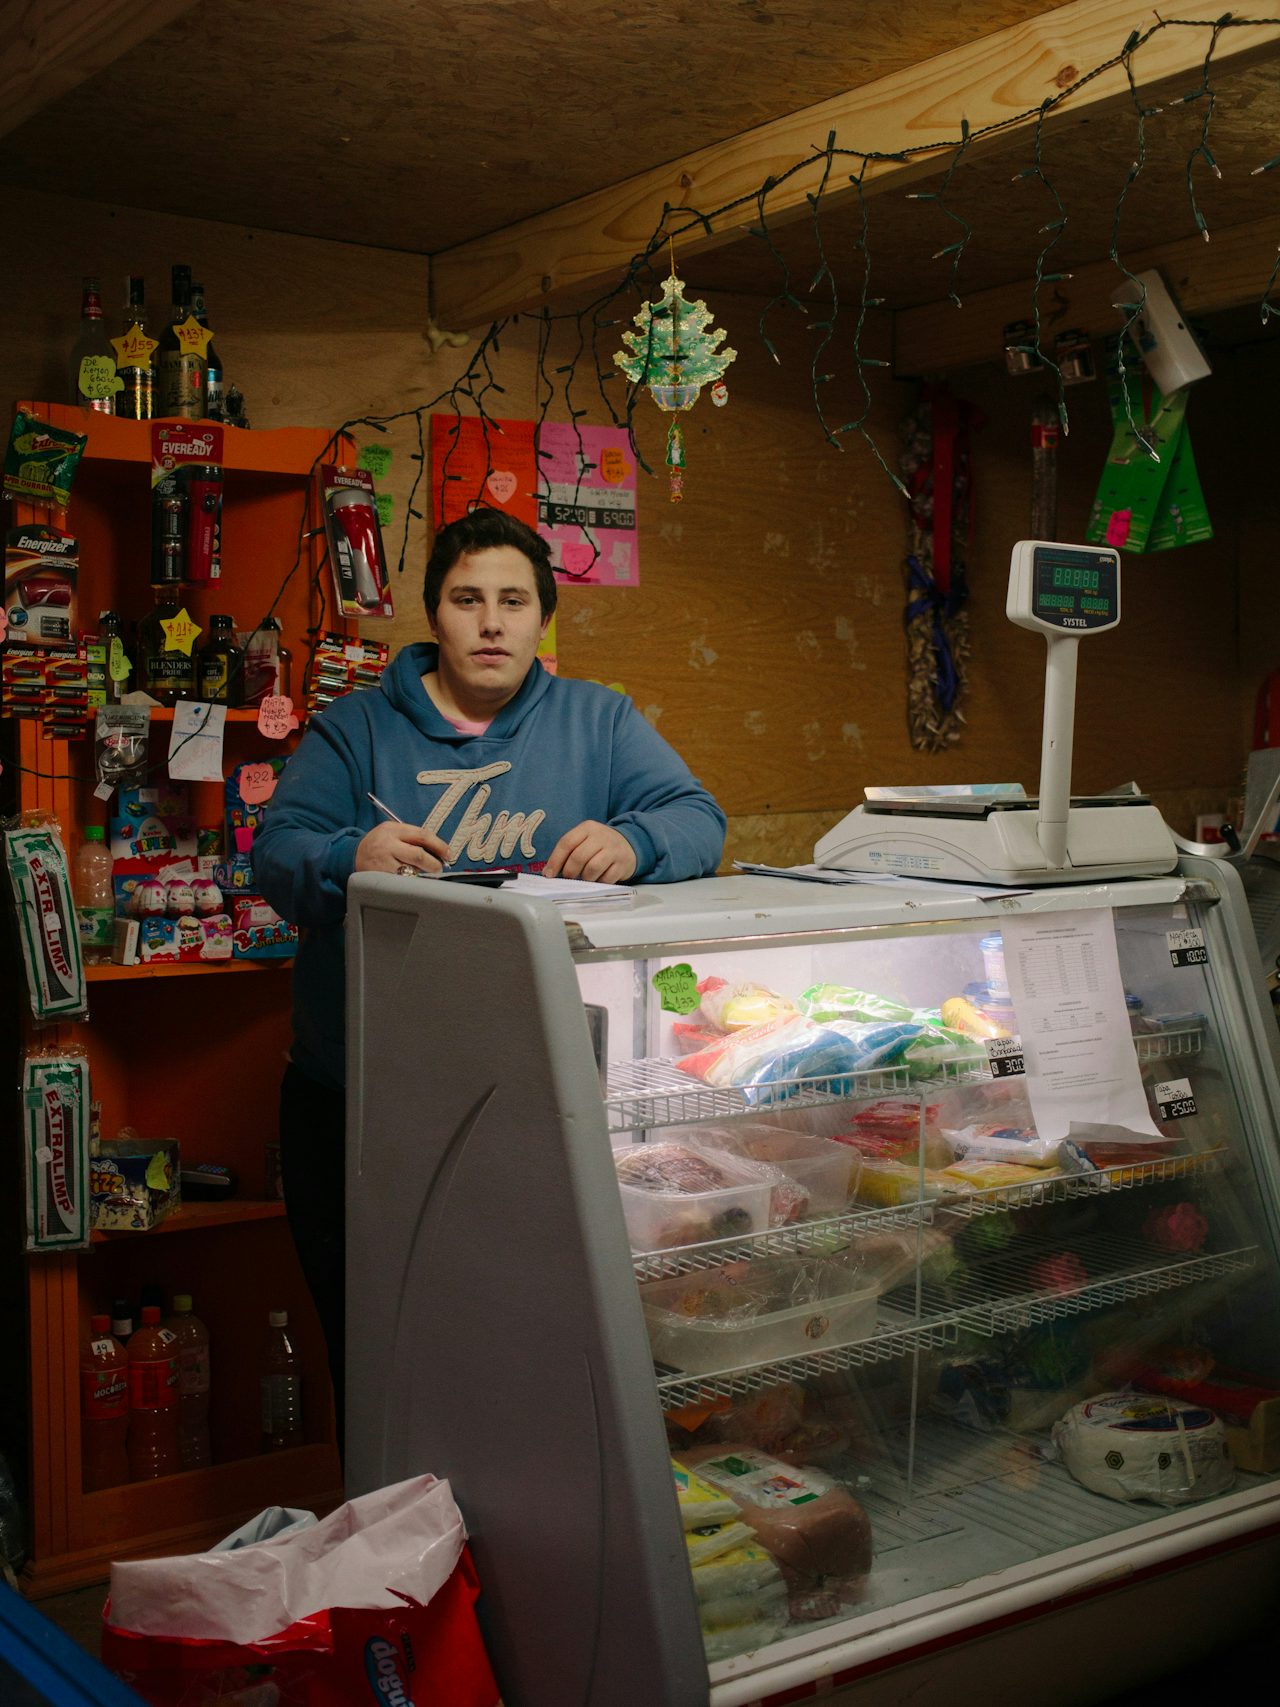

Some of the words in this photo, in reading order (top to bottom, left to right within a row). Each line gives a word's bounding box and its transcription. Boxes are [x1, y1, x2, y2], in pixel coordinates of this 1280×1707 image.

[162, 441, 214, 457] EVEREADY
[333, 475, 364, 489] EVEREADY
[17, 535, 68, 553] Energizer
[1063, 617, 1088, 628] SYSTEL
[150, 659, 192, 670] BLENDERS
[29, 857, 70, 978] EXTRLIMP
[45, 1089, 70, 1216] EXTRALIMP
